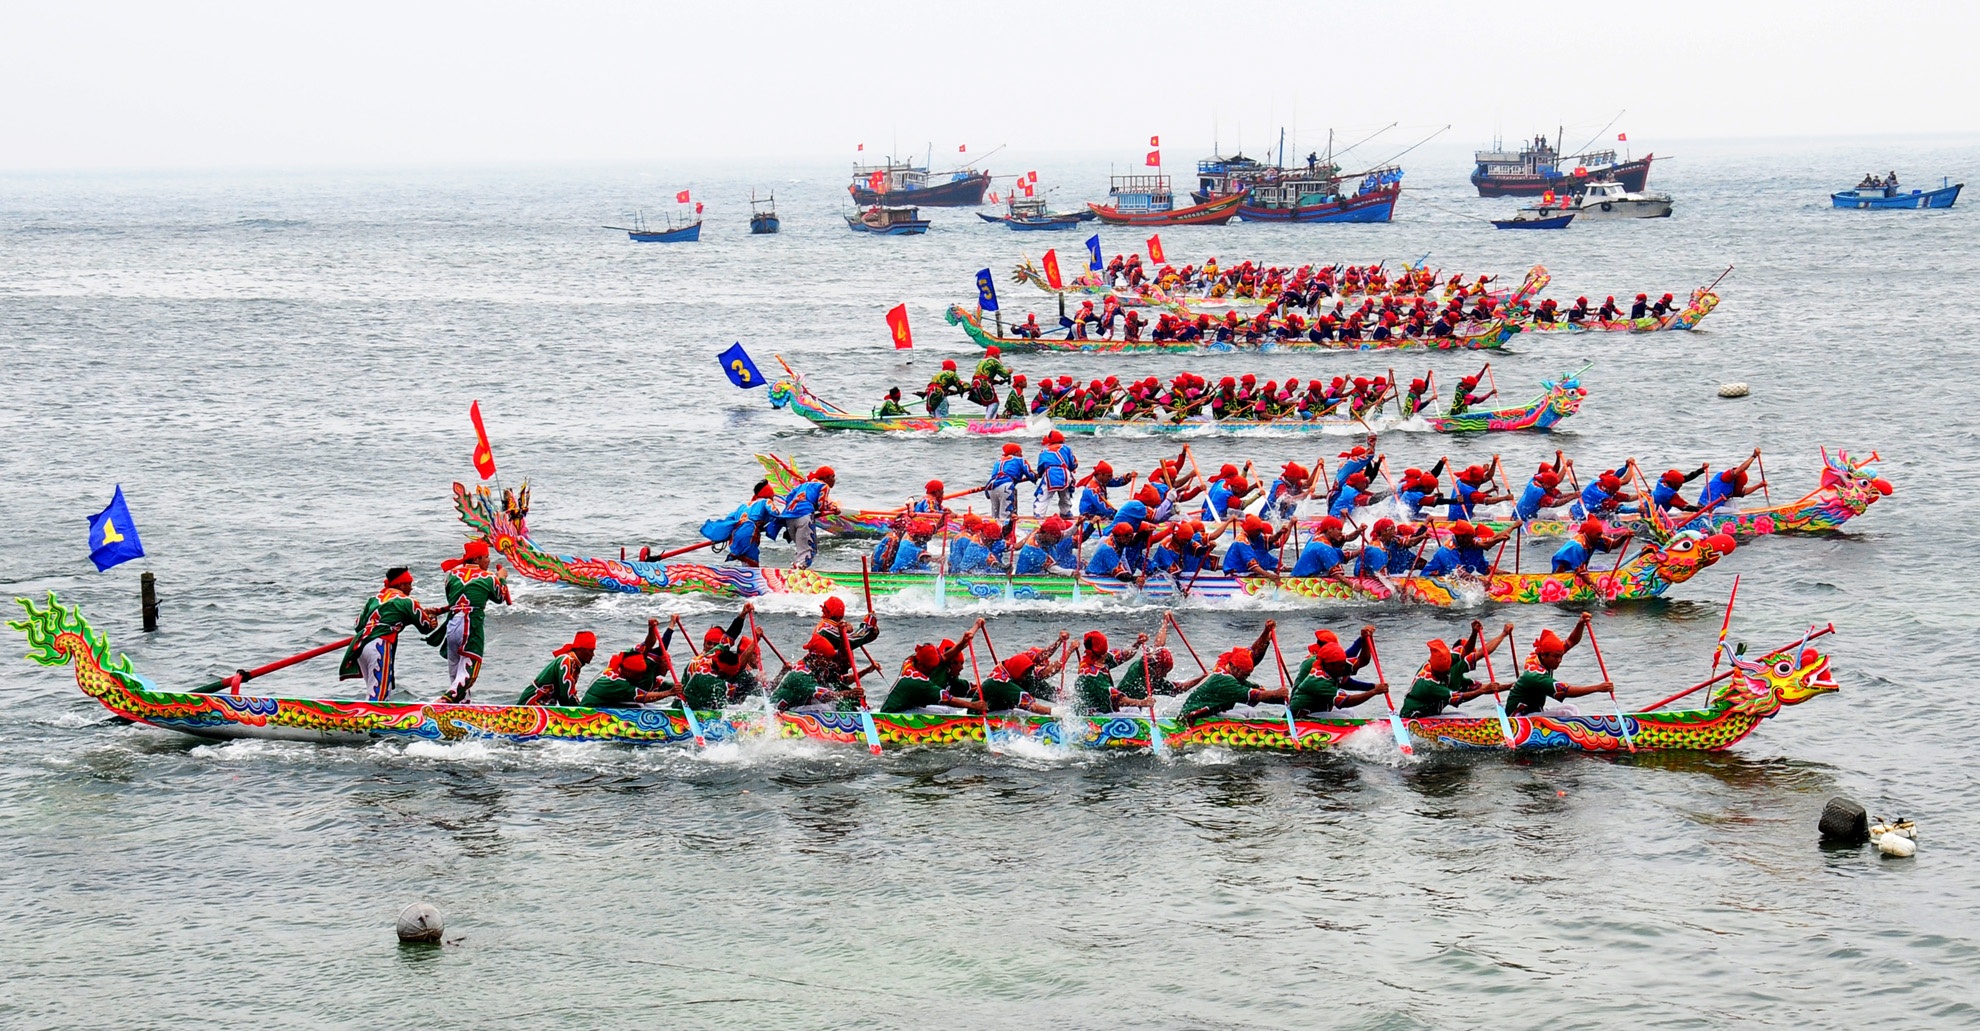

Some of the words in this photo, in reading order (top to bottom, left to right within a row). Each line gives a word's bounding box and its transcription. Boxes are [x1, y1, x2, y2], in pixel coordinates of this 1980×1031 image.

[979, 279, 992, 300] 5
[897, 320, 906, 341] 4
[731, 359, 751, 382] 3
[102, 517, 124, 546] 1
